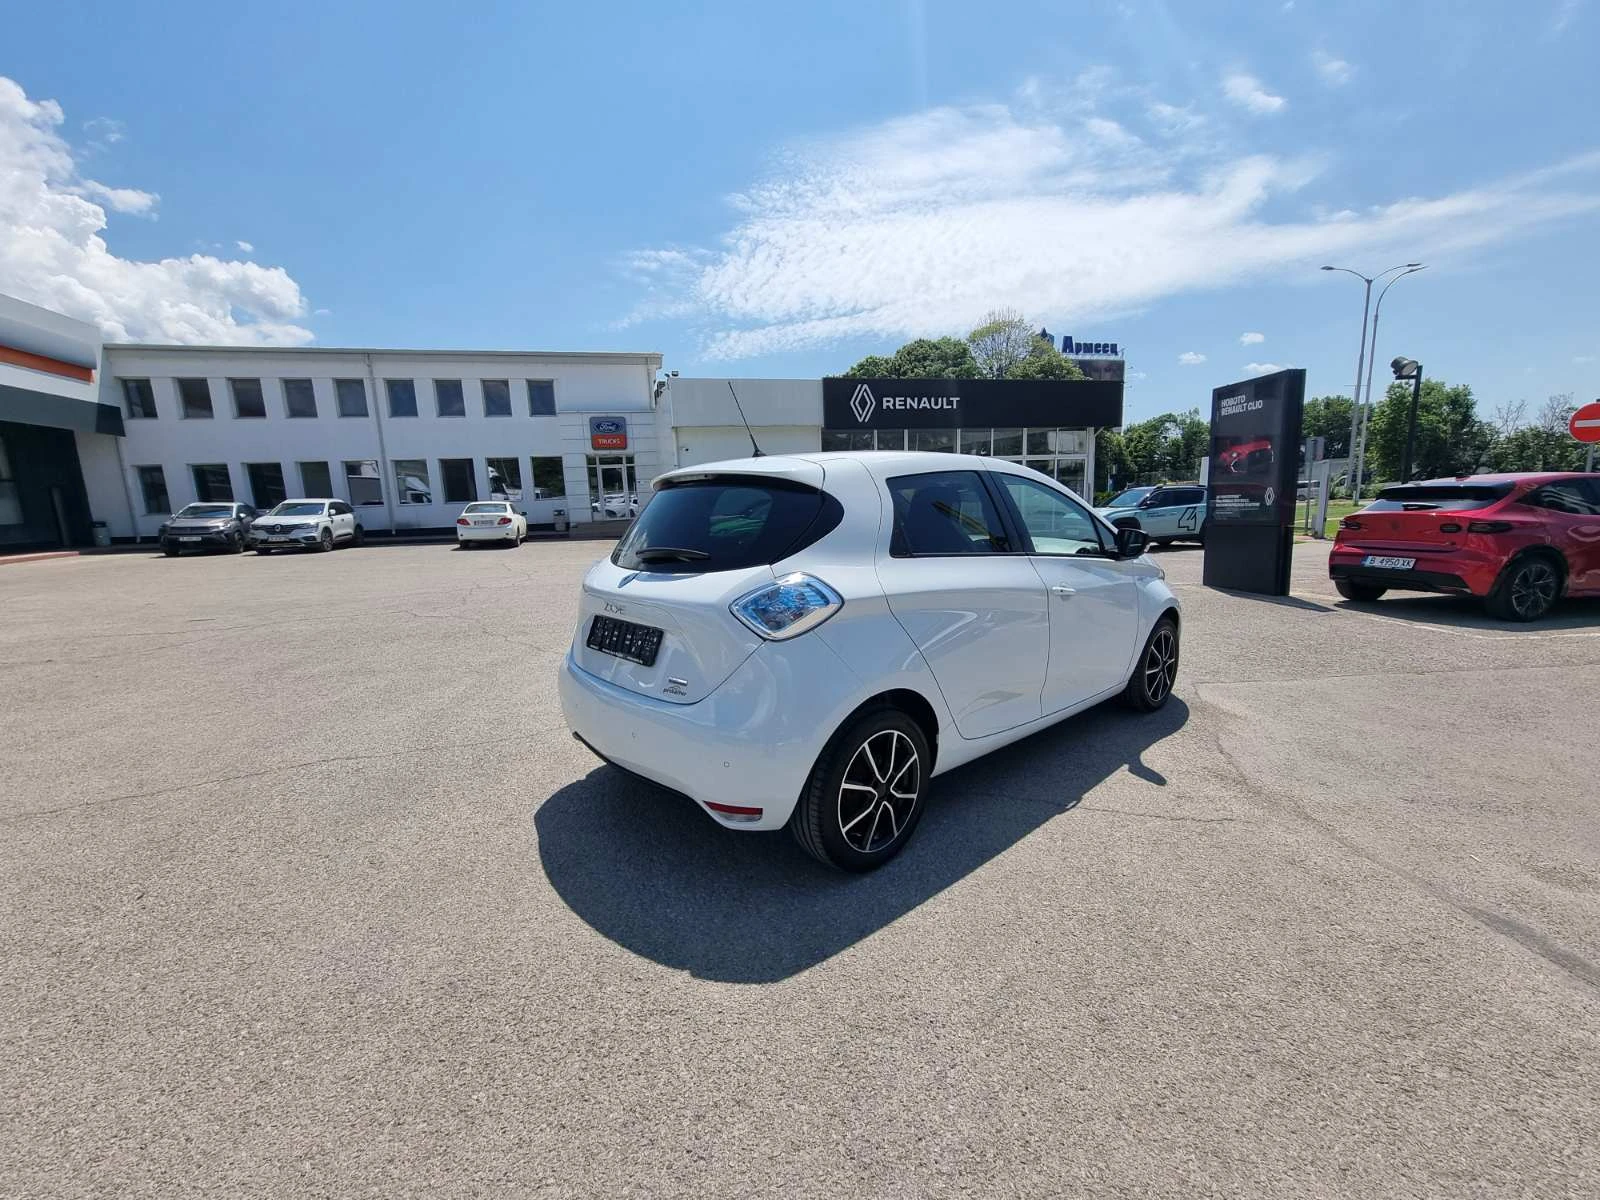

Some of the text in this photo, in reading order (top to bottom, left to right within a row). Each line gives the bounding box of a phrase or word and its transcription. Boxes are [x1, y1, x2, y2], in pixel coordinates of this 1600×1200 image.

[882, 397, 960, 410] RENAULT
[1247, 399, 1263, 411] CLIO
[1379, 557, 1400, 567] 4950
